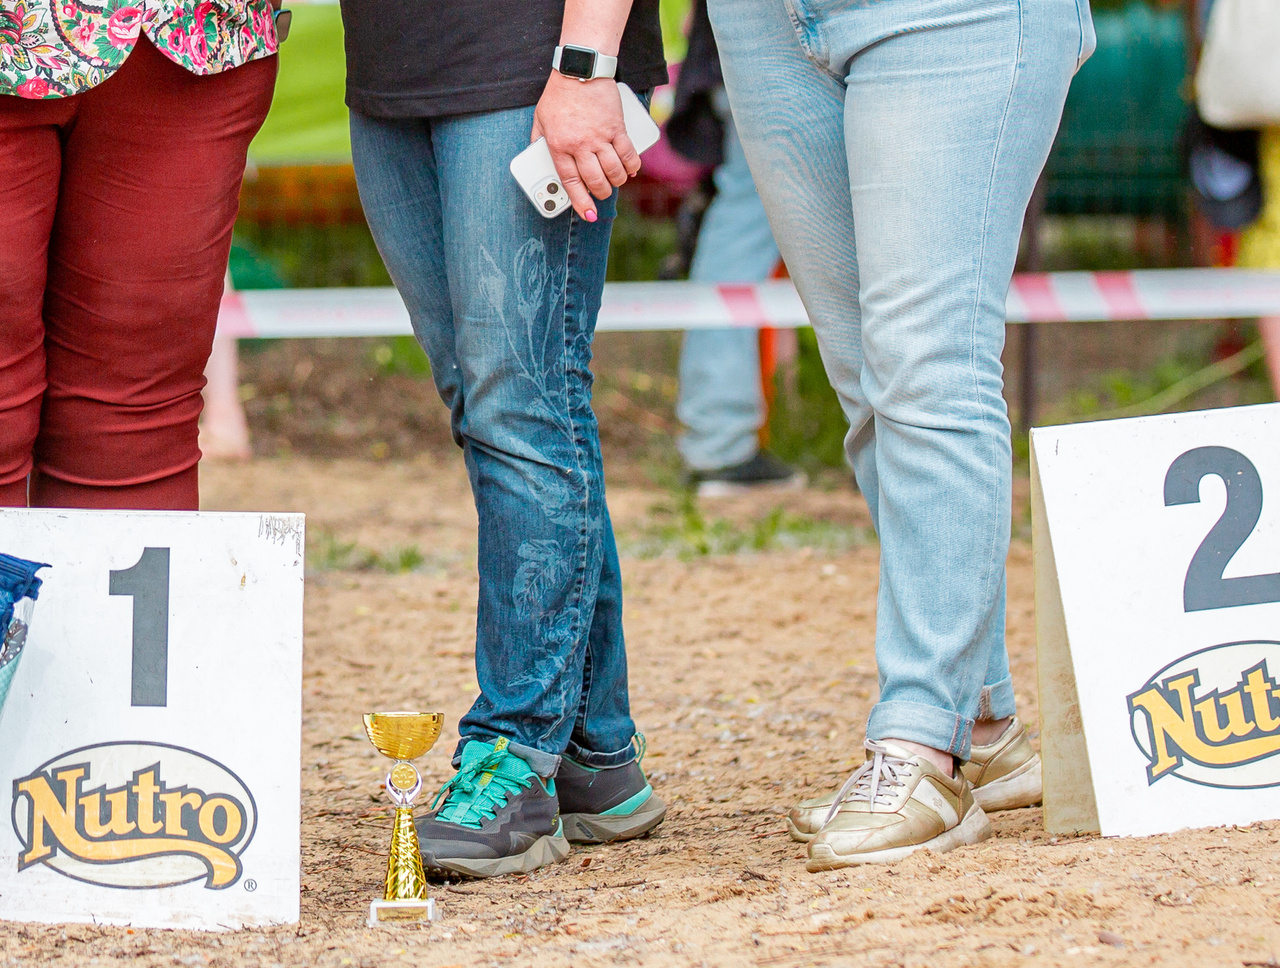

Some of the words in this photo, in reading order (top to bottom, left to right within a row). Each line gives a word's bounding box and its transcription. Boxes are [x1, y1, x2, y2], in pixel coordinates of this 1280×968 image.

[1163, 445, 1280, 613] 2
[108, 546, 171, 708] 1
[1128, 661, 1280, 785] Nut
[14, 763, 246, 872] Nutro
